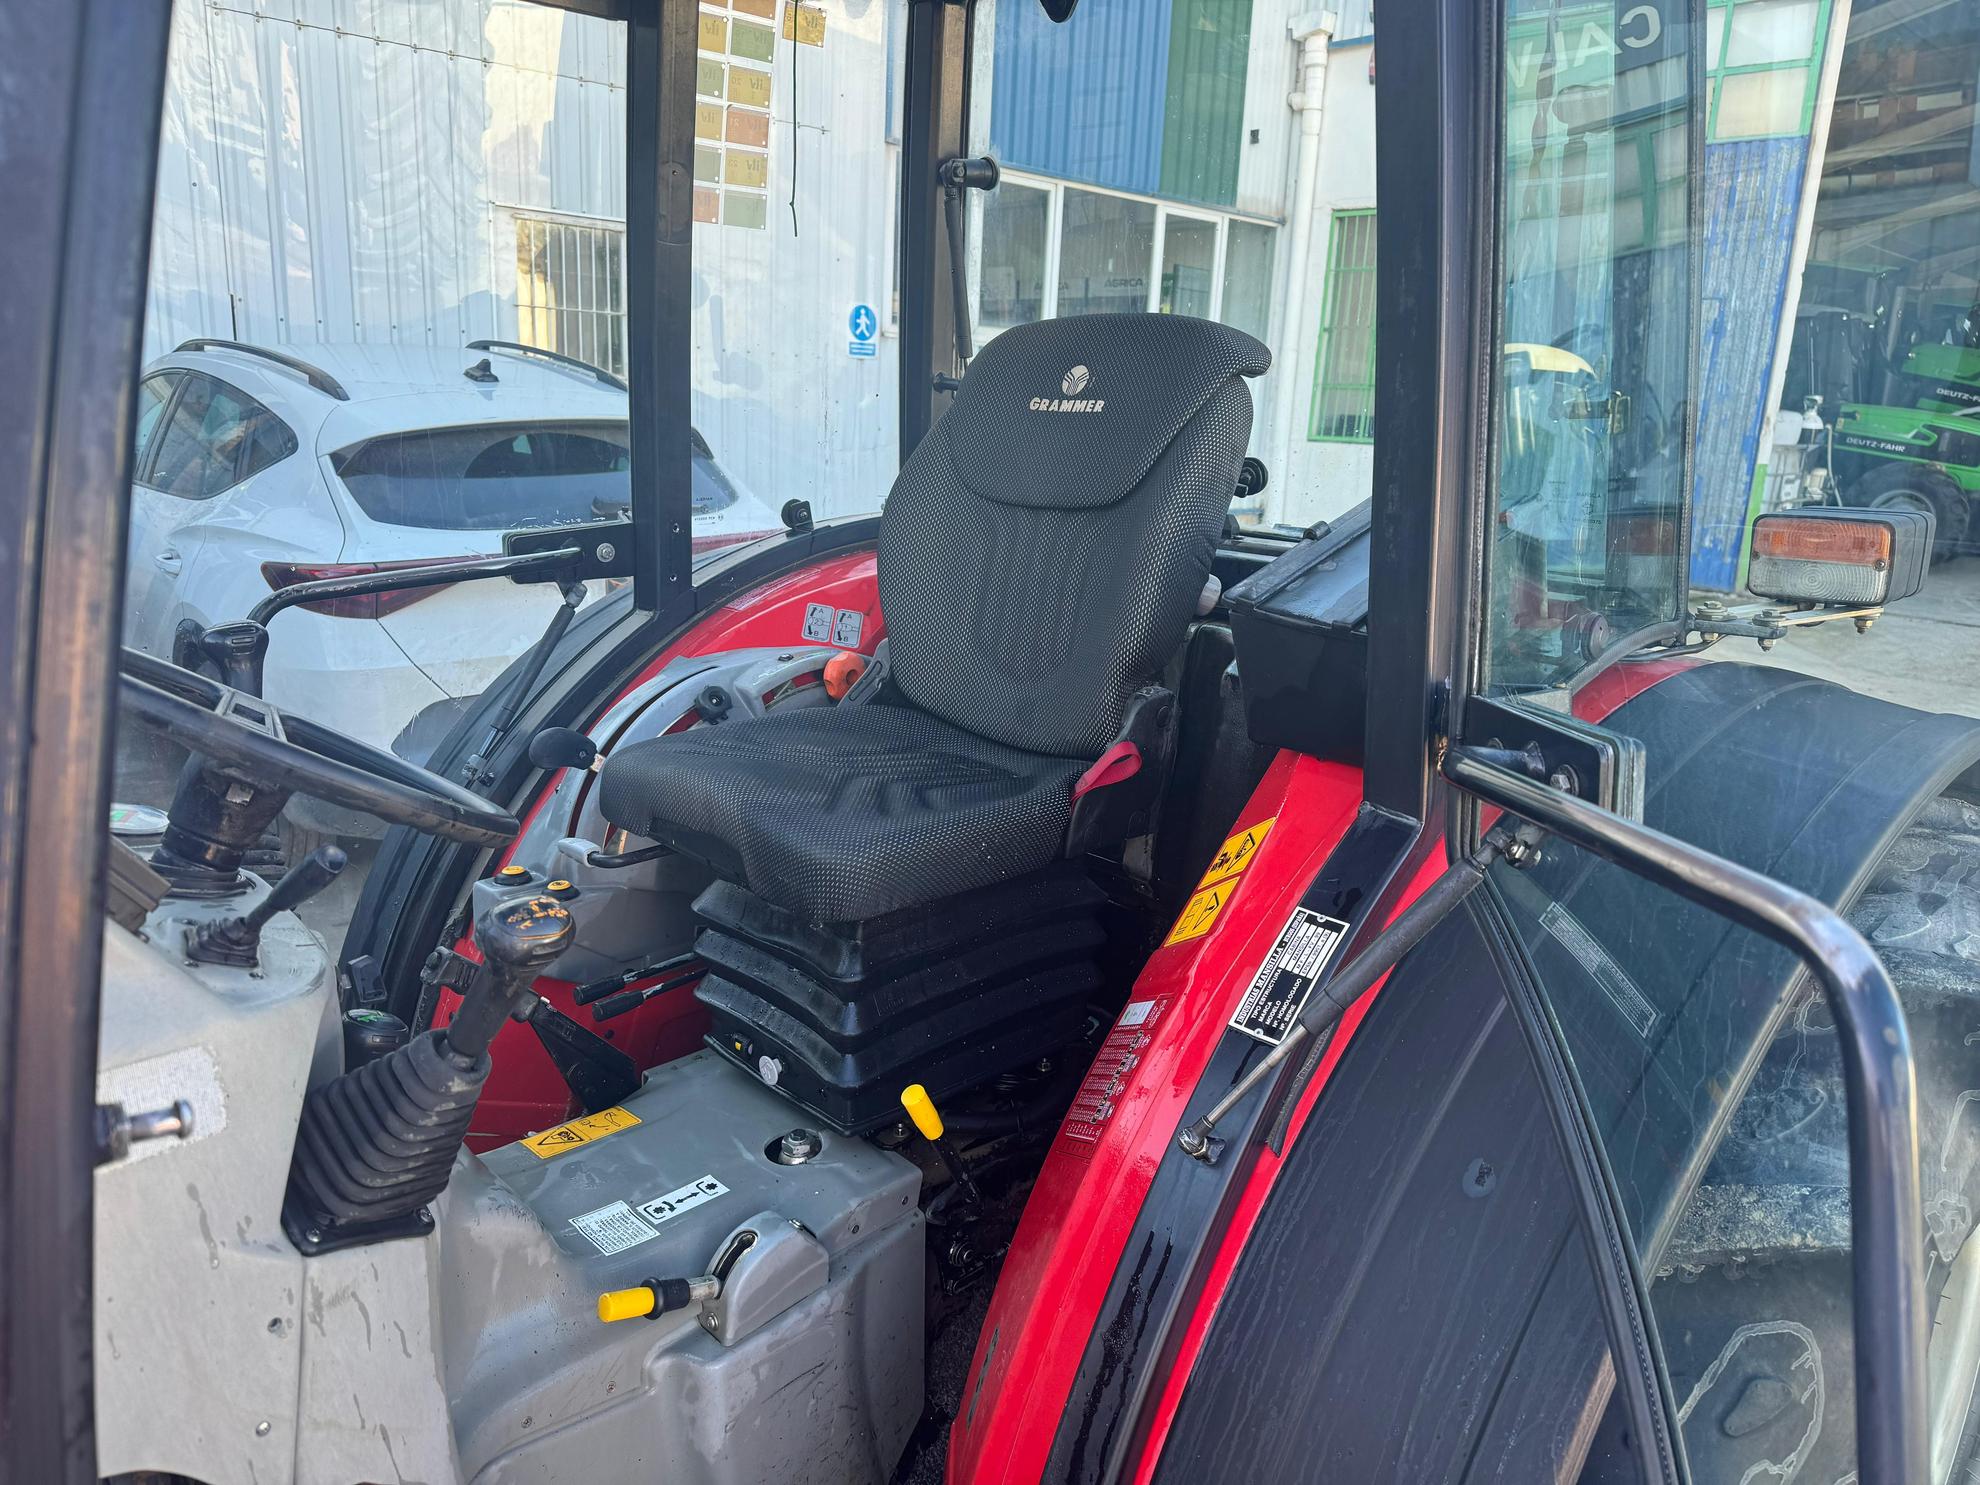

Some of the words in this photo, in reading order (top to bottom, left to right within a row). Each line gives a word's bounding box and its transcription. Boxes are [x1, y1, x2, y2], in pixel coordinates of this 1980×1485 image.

[1029, 397, 1105, 413] GRAMMER
[1846, 436, 1907, 453] DEUTZ-FAHR
[1236, 985, 1262, 1024] INDUSTRIAS
[1256, 946, 1285, 990] MANSILLA
[1251, 1005, 1262, 1020] TIPO
[1259, 968, 1282, 1006] ESTRUCTURA
[1277, 978, 1303, 1020] HOMOLOGADO
[1258, 1001, 1273, 1023] MARCA
[1265, 1000, 1282, 1026] MODELO
[1284, 1003, 1297, 1022] SERIE
